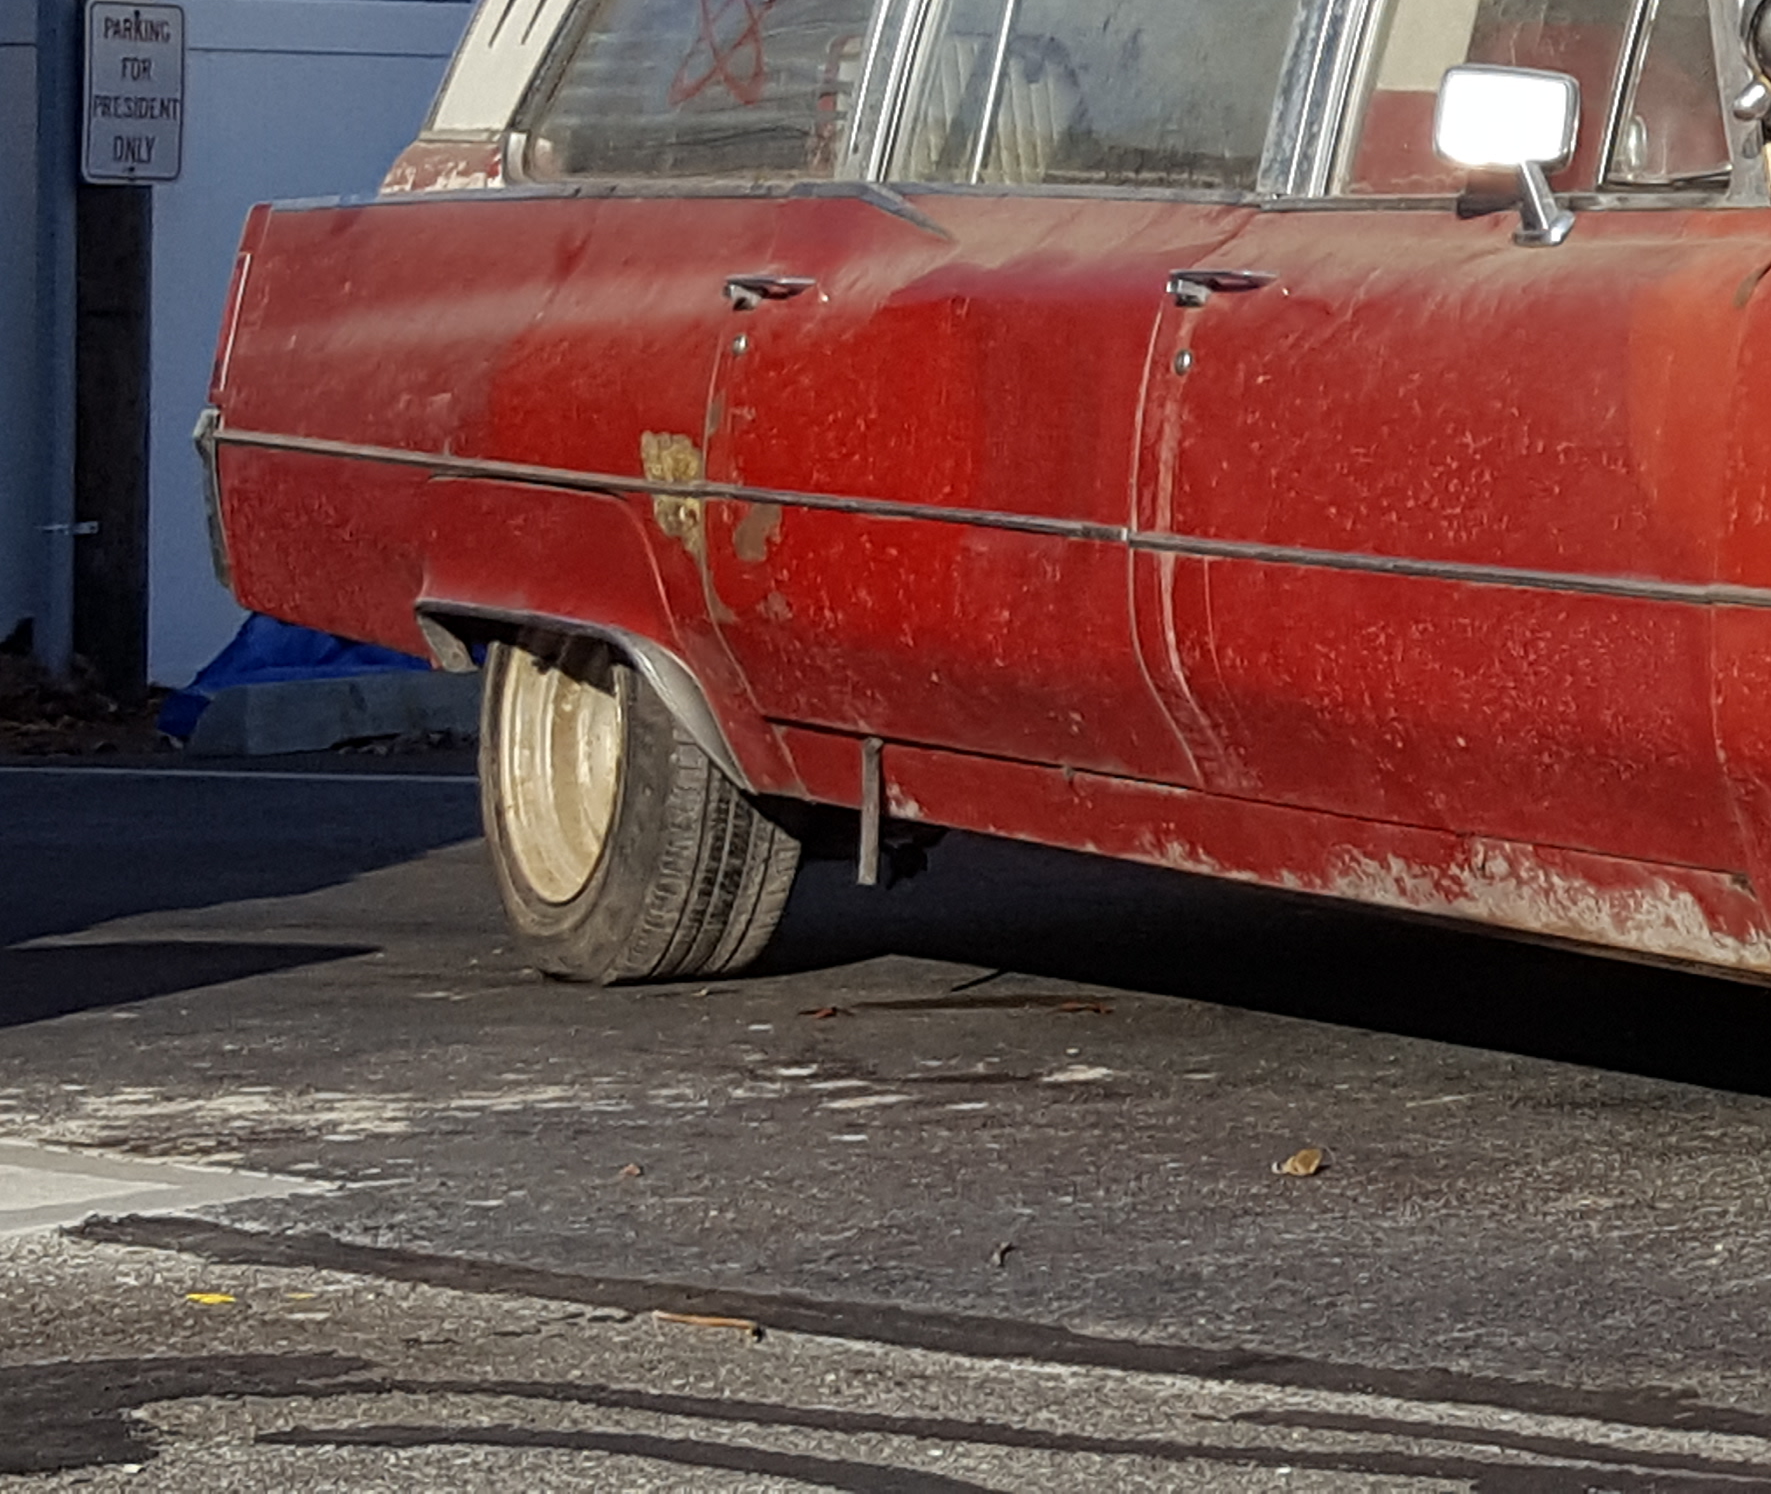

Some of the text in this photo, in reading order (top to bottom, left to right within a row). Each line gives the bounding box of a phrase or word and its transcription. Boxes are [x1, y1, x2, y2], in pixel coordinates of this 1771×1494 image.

[103, 16, 171, 44] PARKING
[121, 57, 151, 81] FOR
[93, 94, 181, 121] PRESIDENT
[113, 135, 157, 165] ONLY
